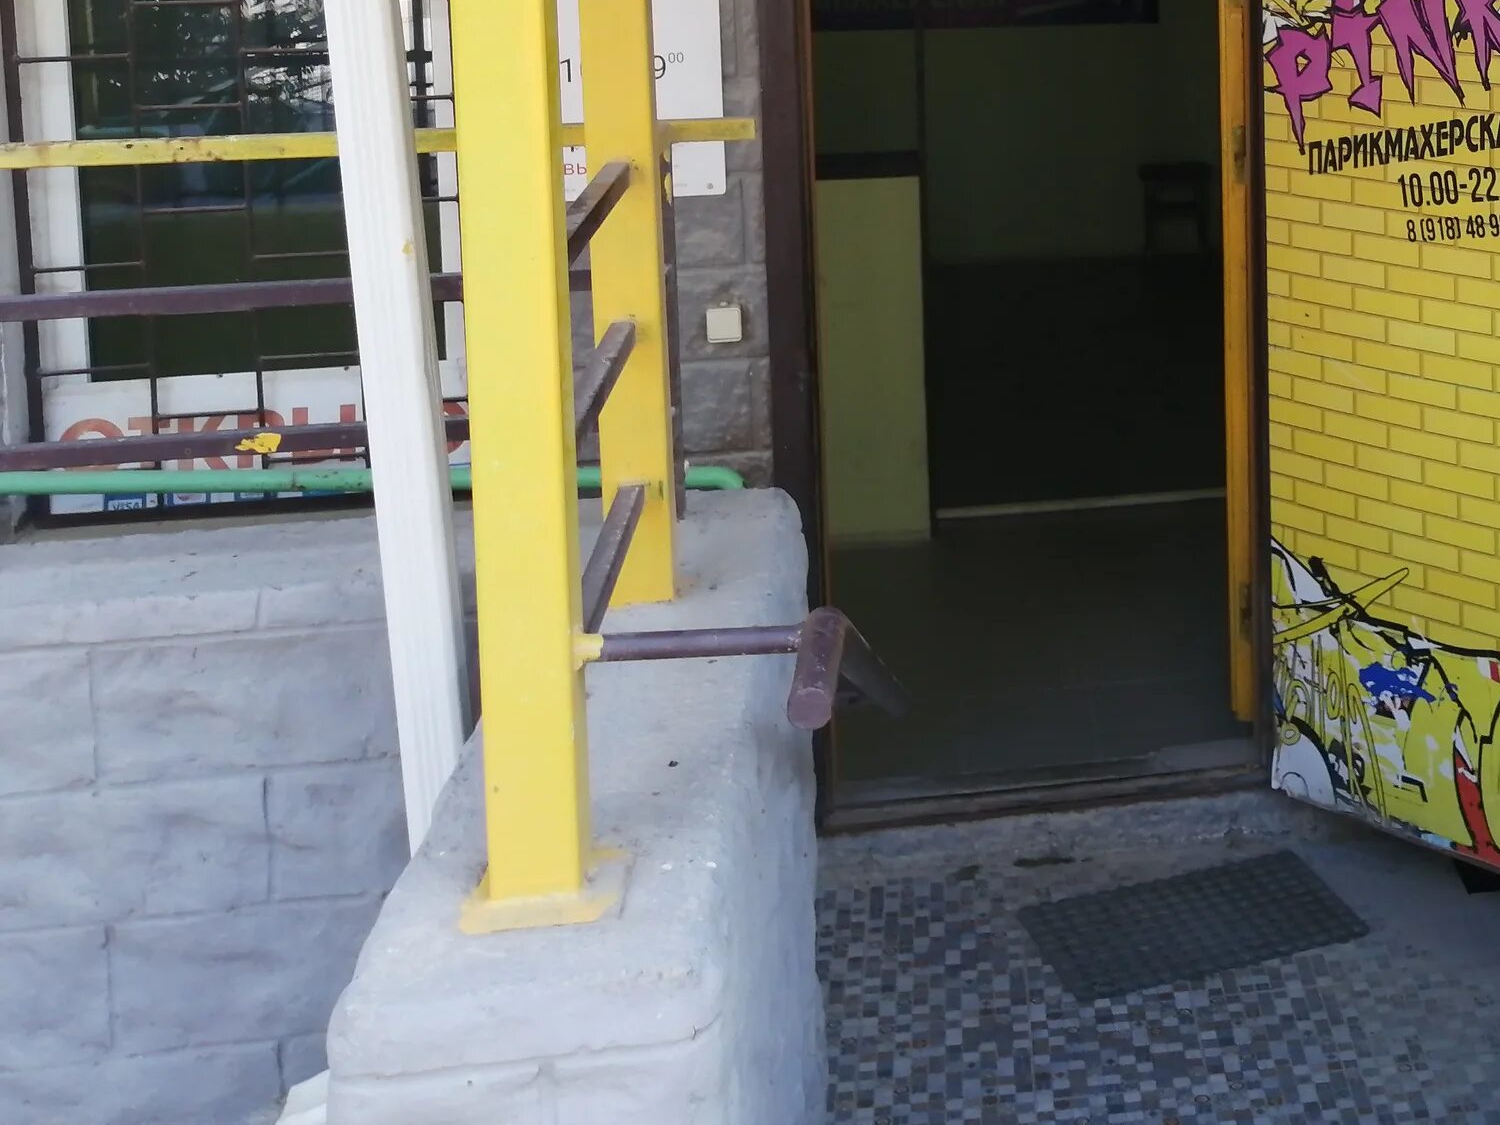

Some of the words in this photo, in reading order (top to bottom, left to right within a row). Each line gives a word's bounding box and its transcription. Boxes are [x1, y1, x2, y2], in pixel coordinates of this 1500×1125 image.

[1406, 219, 1417, 242] 8
[1420, 216, 1462, 242] (918)
[1466, 215, 1486, 238] 48
